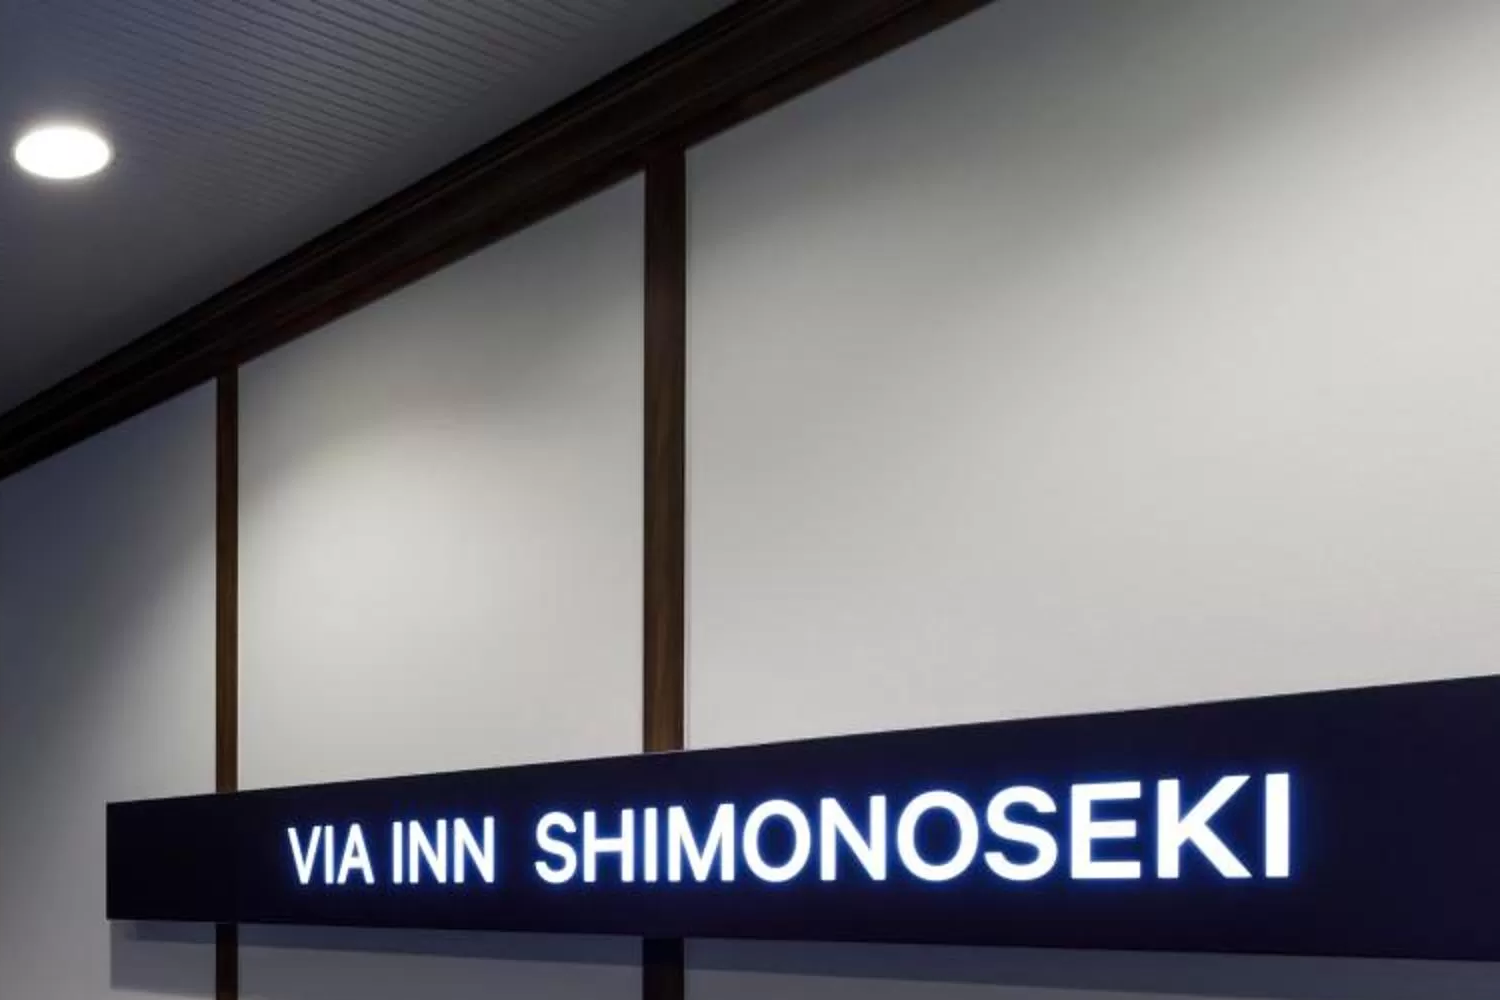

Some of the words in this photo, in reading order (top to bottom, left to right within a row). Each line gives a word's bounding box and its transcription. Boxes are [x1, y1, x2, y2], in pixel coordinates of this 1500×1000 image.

[286, 823, 376, 885] VIA
[392, 815, 496, 885] INN
[534, 772, 1291, 885] SHIMONOSEKI
